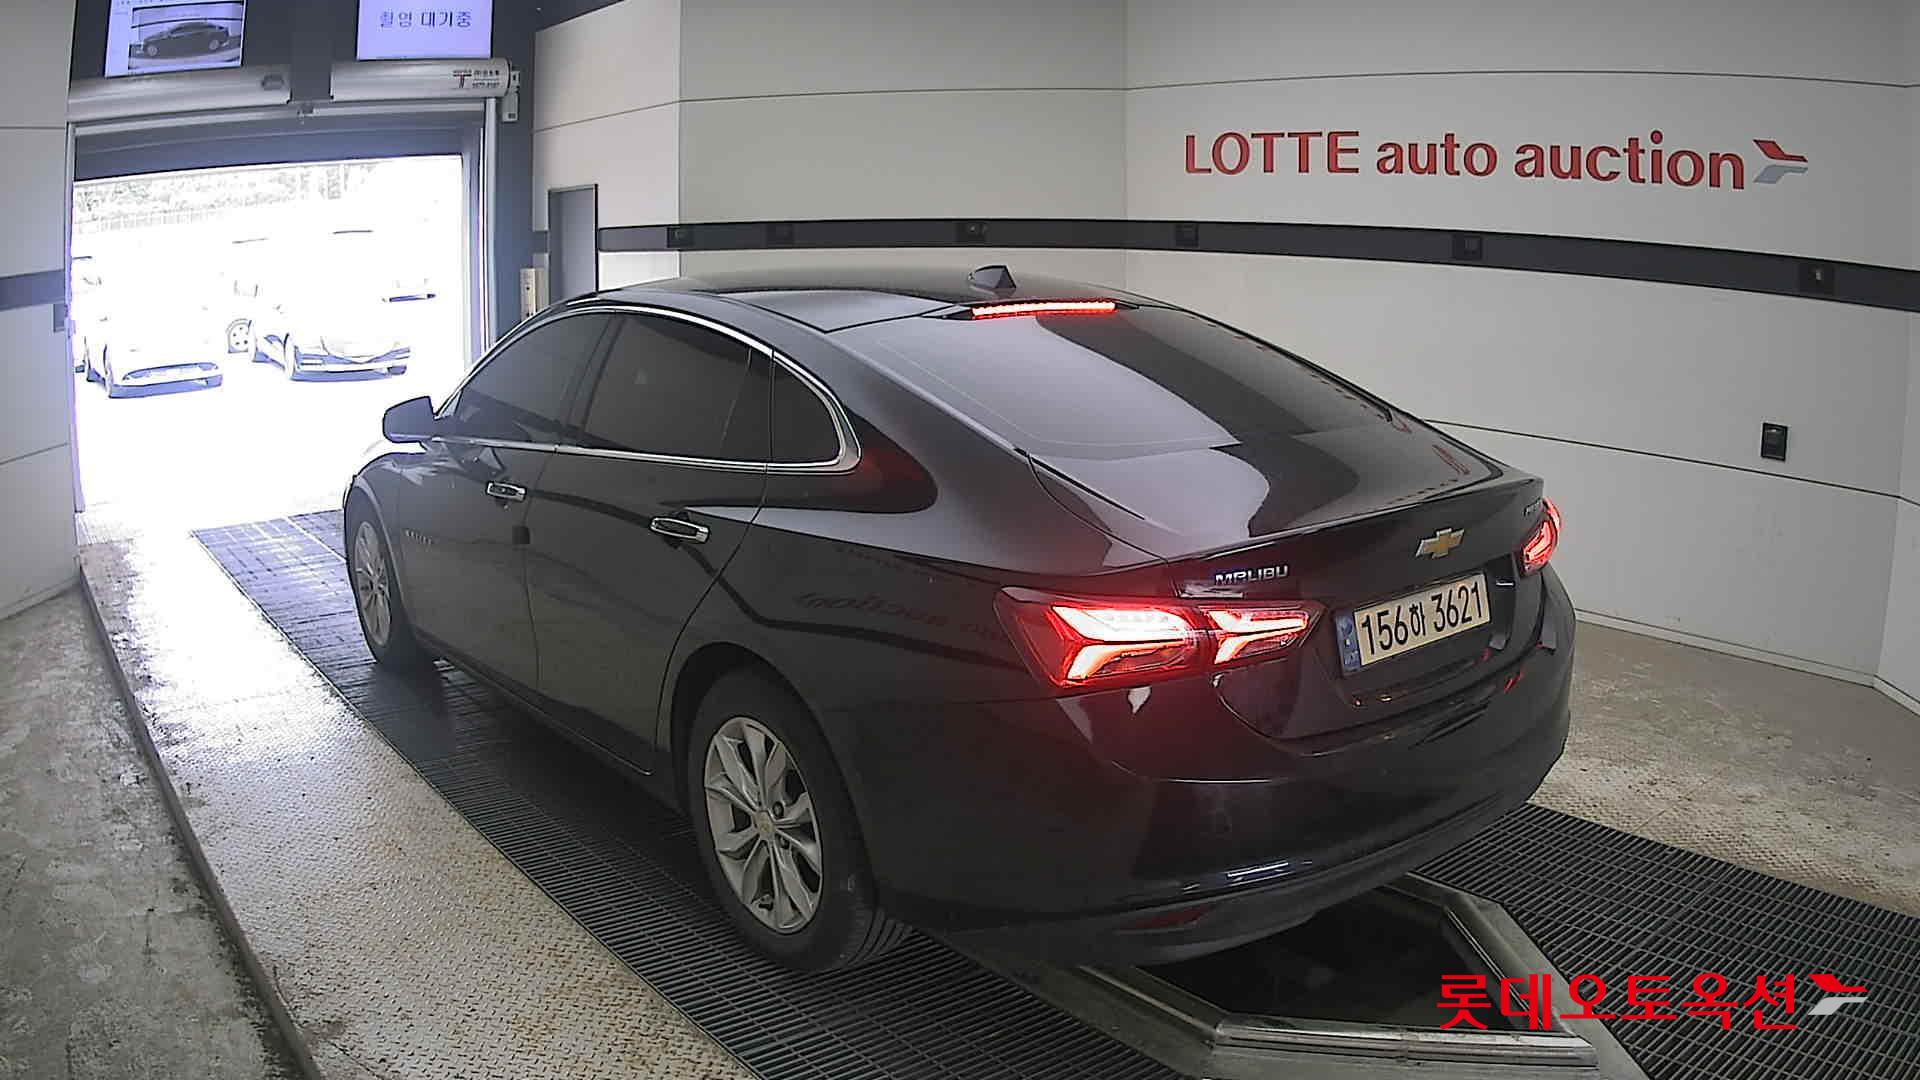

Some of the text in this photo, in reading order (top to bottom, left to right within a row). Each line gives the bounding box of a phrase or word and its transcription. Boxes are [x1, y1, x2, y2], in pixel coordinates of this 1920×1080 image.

[420, 10, 472, 28] 대기중
[1184, 130, 1745, 190] LOTTE auto auction
[1214, 564, 1289, 586] MALIBU
[1360, 580, 1483, 656] 156하 3621
